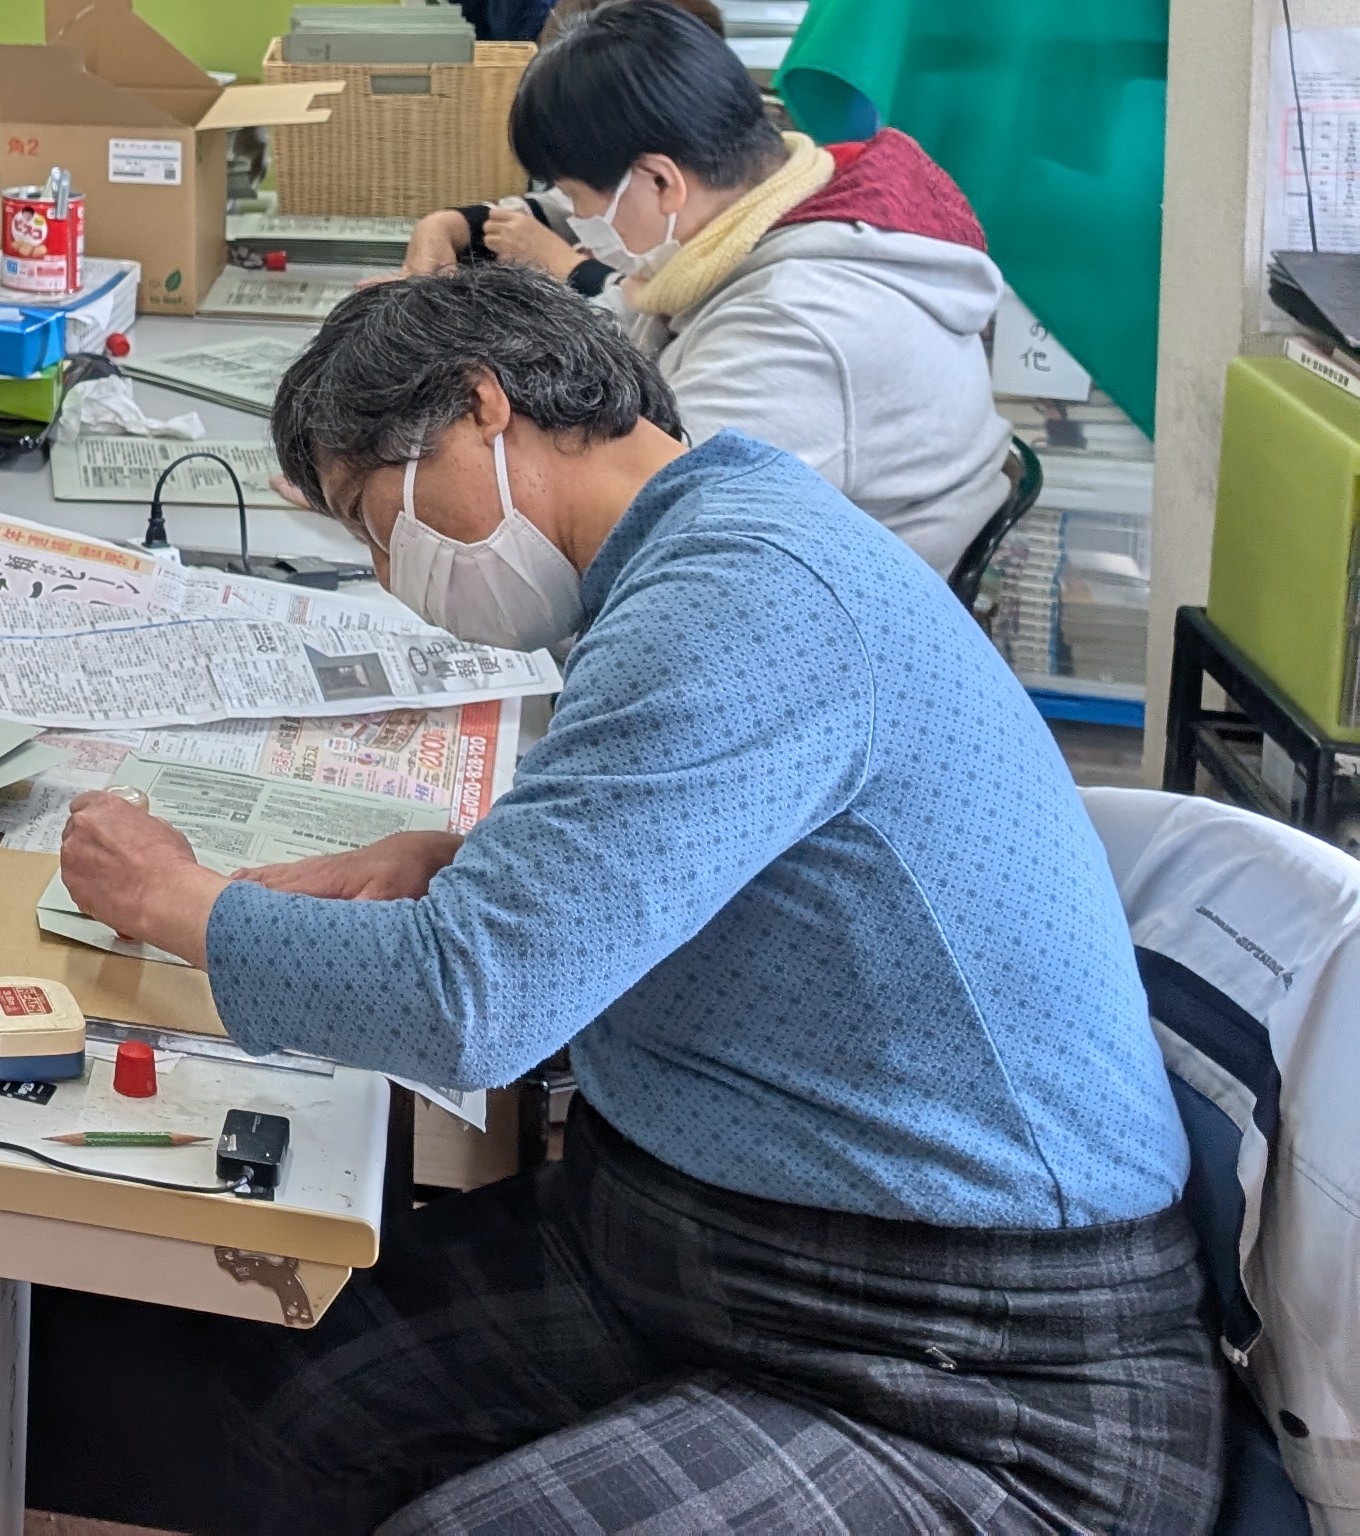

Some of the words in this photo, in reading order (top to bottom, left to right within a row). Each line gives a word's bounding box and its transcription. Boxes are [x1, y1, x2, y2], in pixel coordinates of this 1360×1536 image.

[14, 219, 43, 240] ビスコ
[433, 656, 502, 679] 情報便
